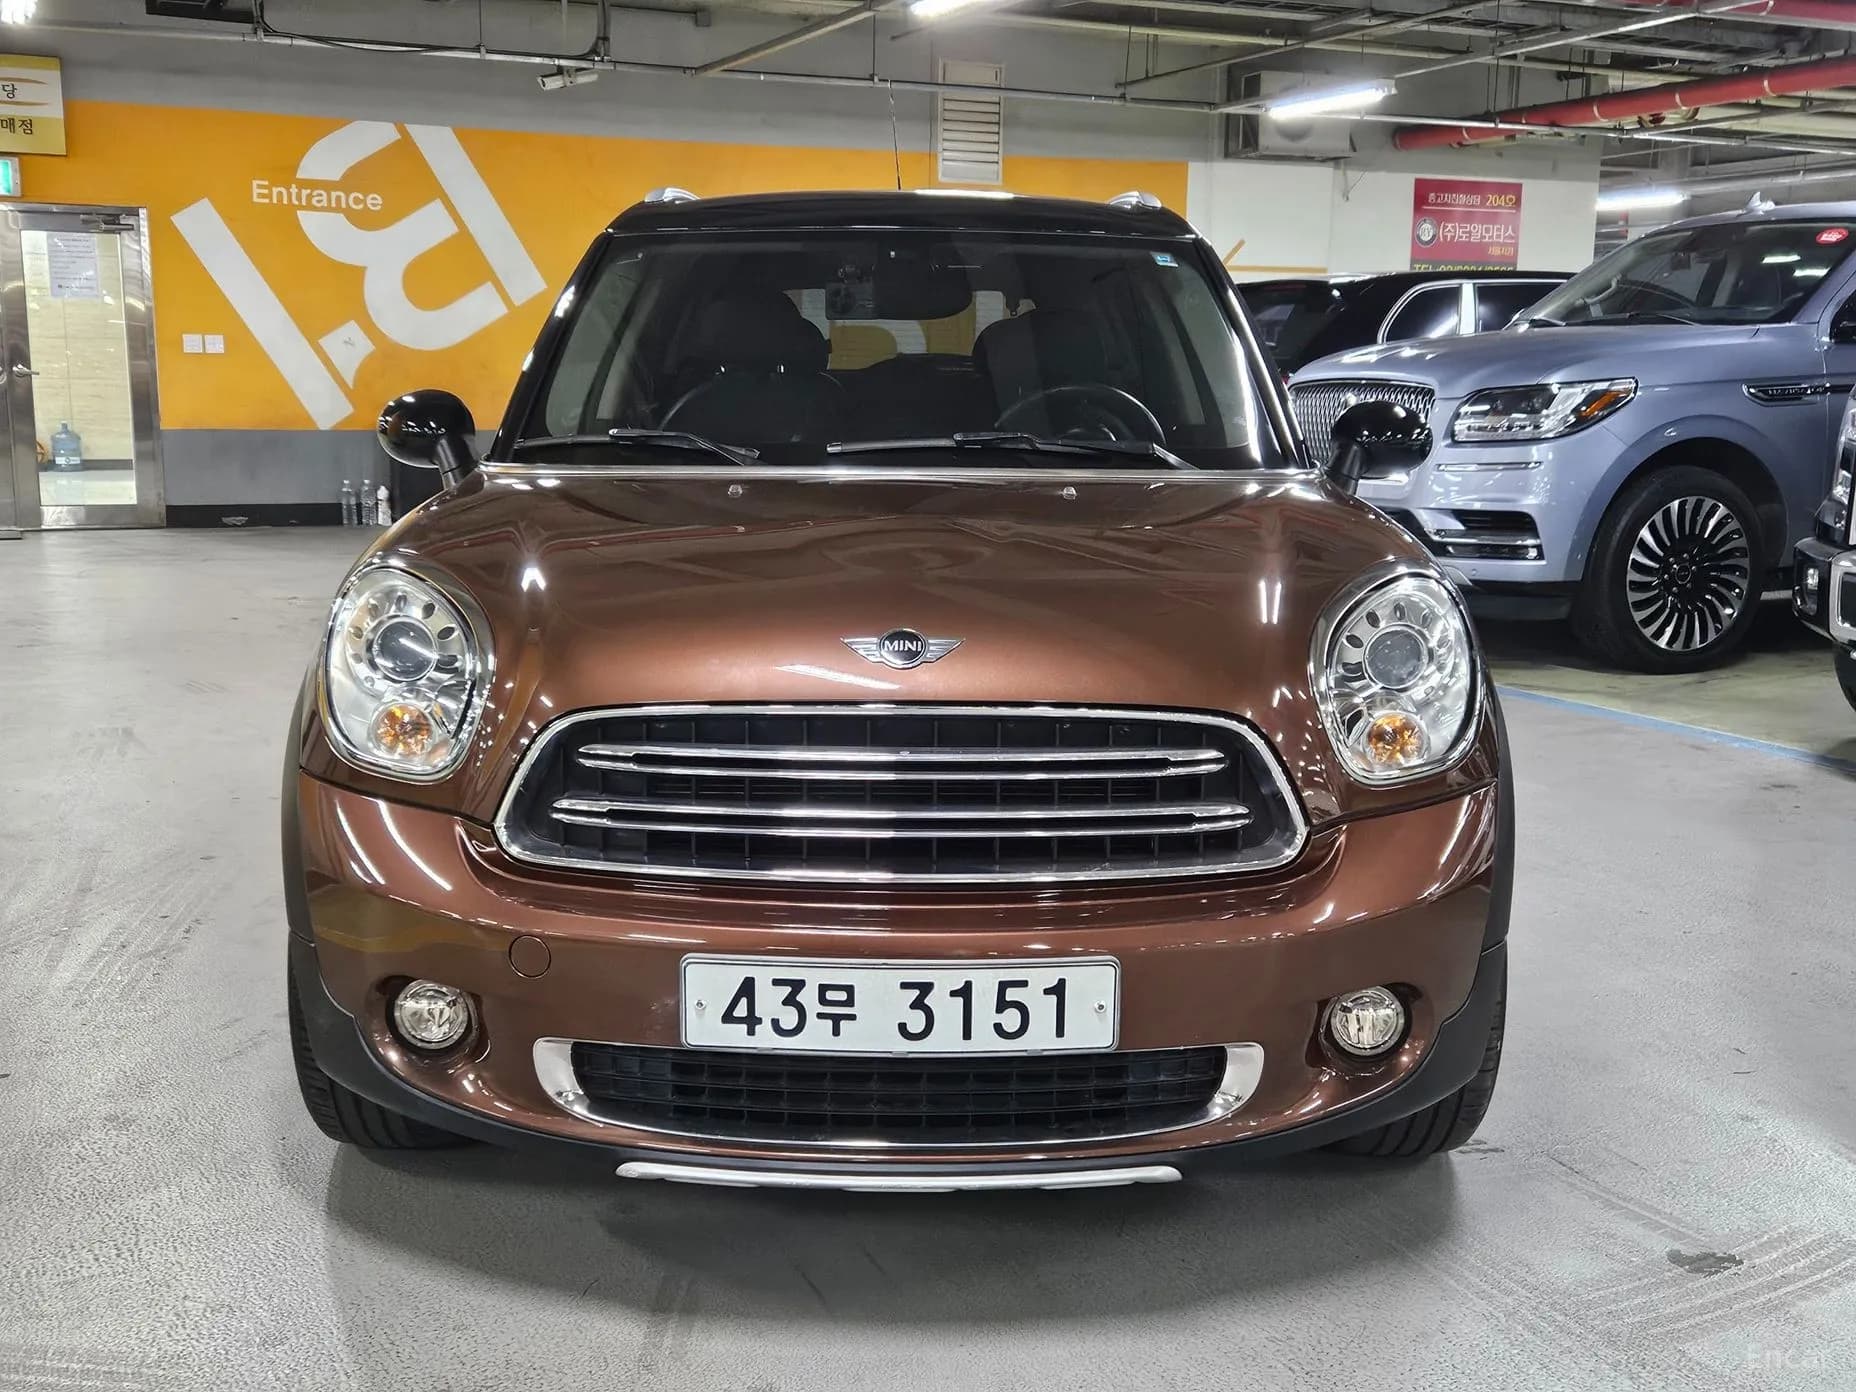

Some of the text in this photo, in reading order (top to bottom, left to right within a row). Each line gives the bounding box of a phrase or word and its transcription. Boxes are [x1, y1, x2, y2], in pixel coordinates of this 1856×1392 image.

[2, 83, 18, 99] 당
[0, 117, 34, 135] 매점
[251, 179, 384, 212] Entrance
[884, 640, 922, 652] MINI
[720, 976, 1067, 1041] 43무 3151
